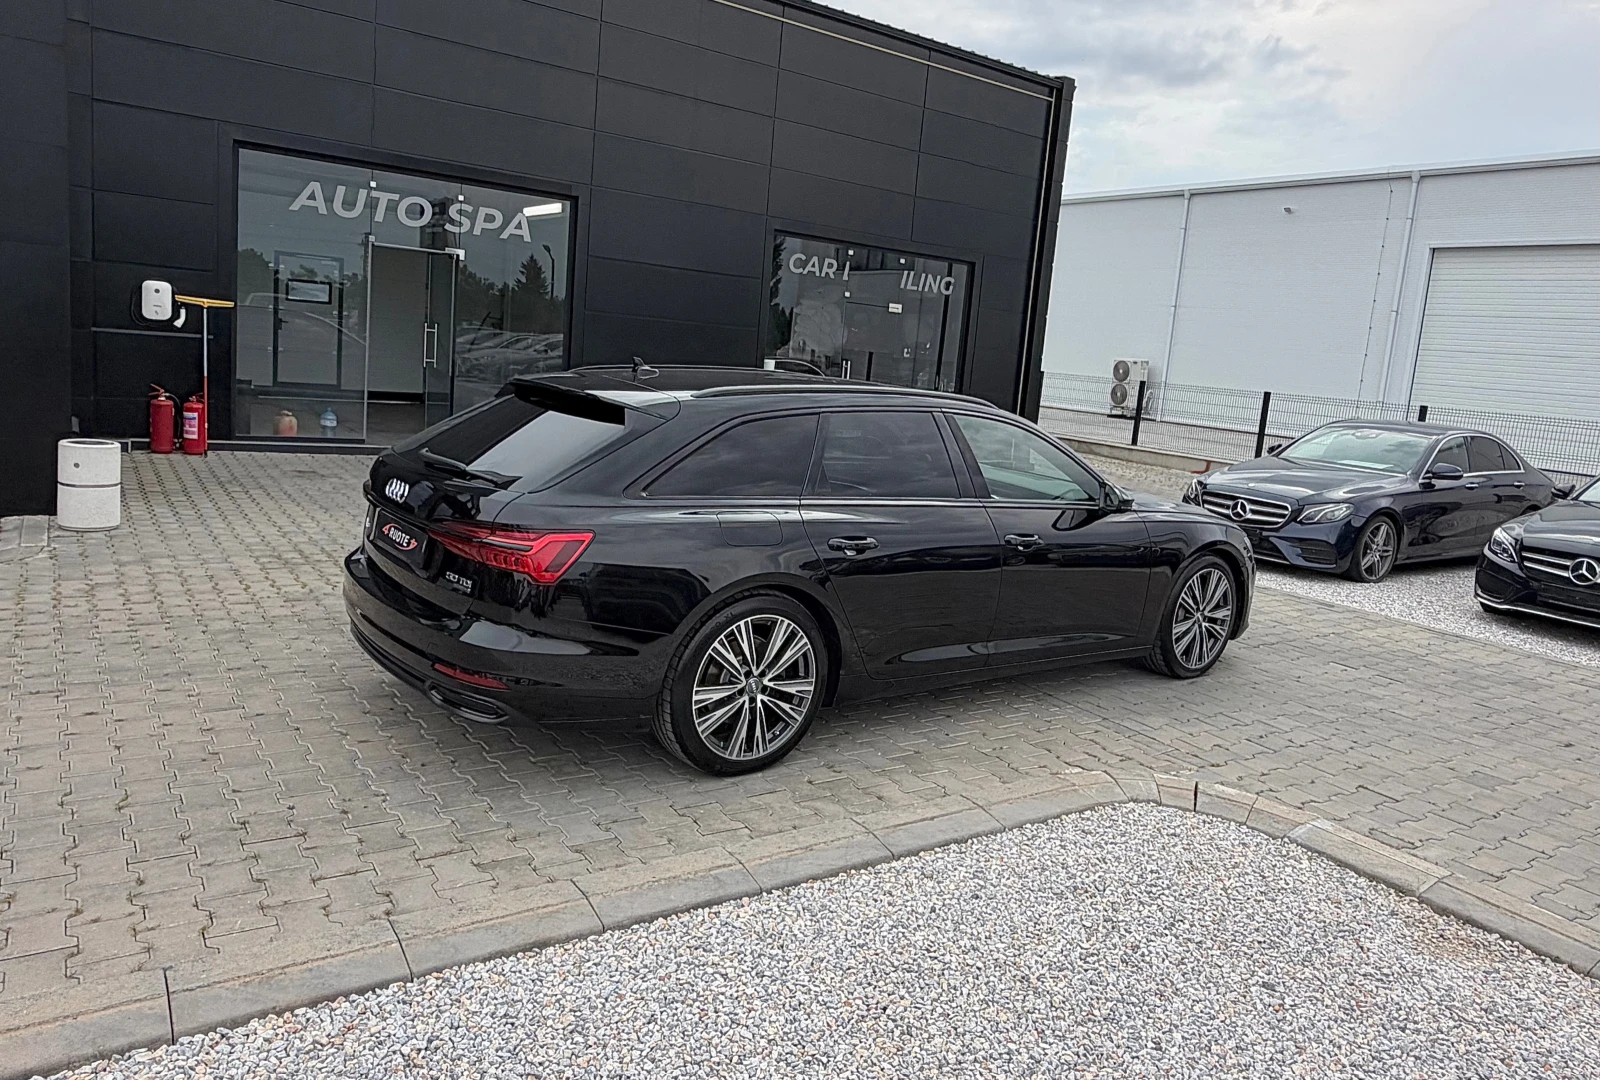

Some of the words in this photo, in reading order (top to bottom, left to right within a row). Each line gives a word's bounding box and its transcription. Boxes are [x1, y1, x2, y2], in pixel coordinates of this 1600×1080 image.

[288, 181, 433, 228] AUTO
[443, 202, 532, 243] SPA
[788, 253, 838, 279] CAR
[388, 526, 411, 547] RUOTE
